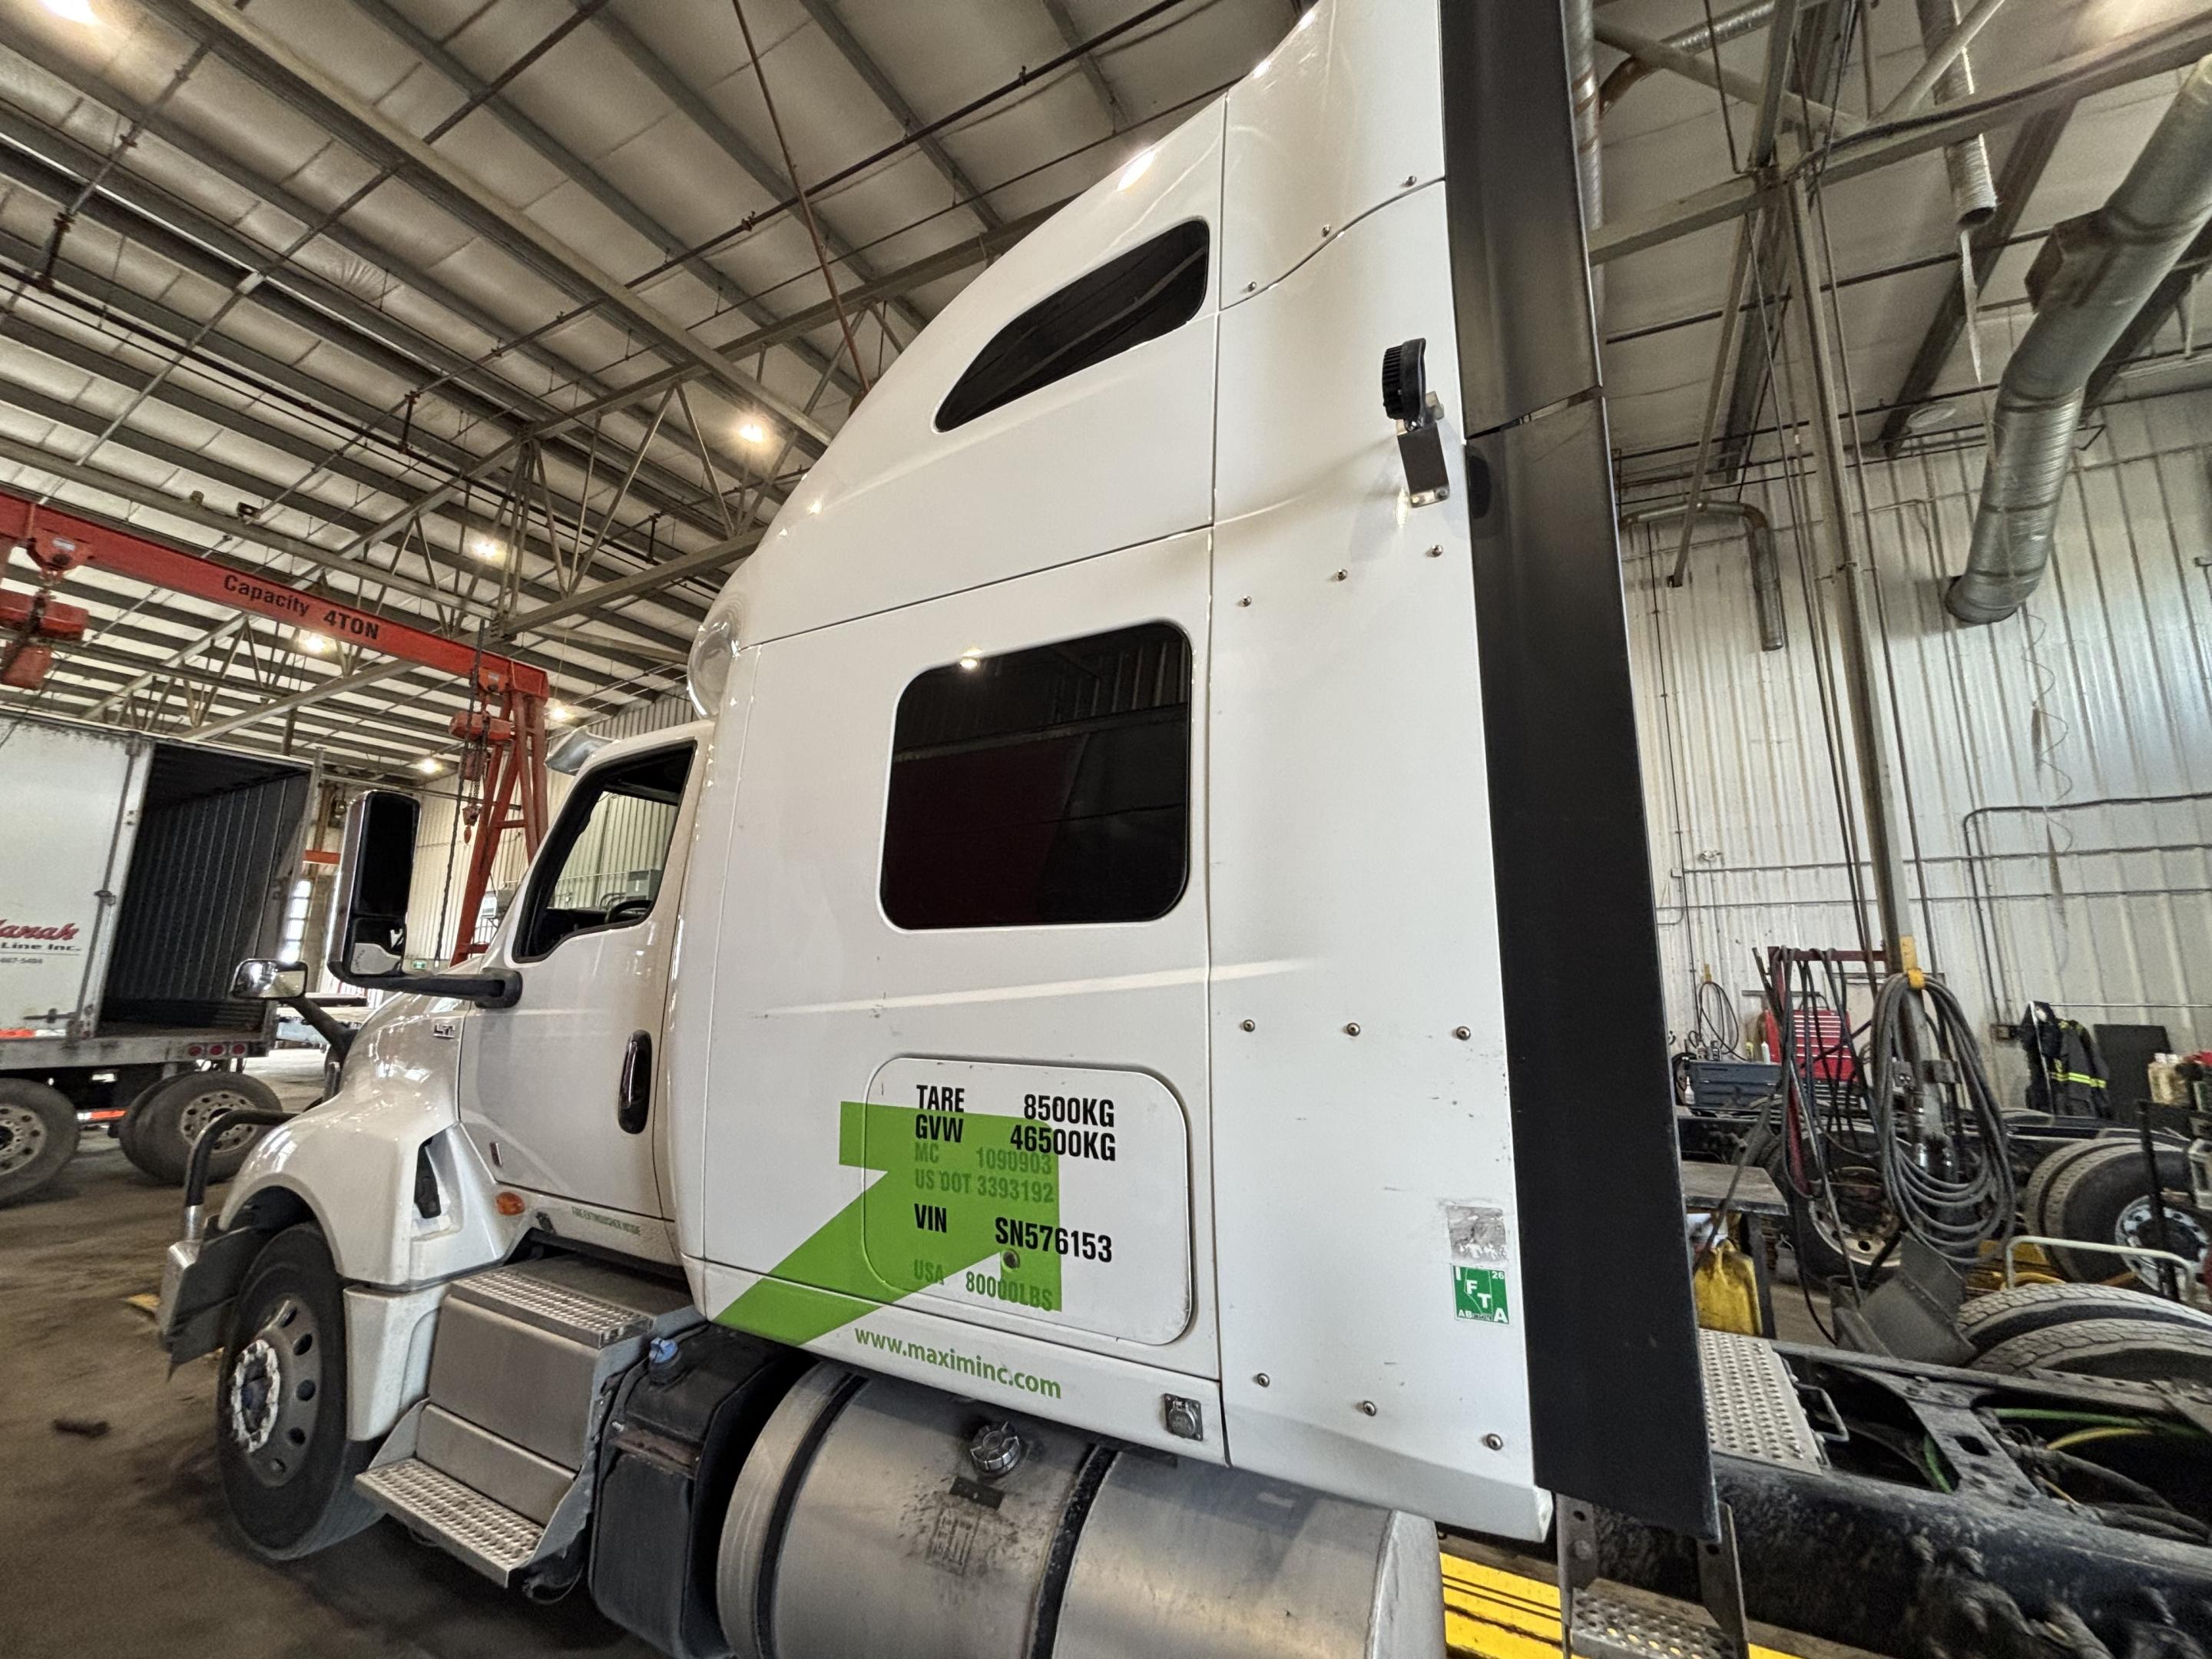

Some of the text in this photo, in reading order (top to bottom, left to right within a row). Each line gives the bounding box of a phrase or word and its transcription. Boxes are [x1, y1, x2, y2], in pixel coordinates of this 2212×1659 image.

[224, 575, 379, 640] Capacity 4TON
[1, 942, 42, 950] Line
[916, 1084, 1114, 1128] TARE 8500KG
[915, 1142, 1051, 1175] MC 1090903
[916, 1114, 1116, 1161] GVW 46500KG
[915, 1168, 1054, 1204] US DOT 3393192
[914, 1203, 1112, 1263] VIN SN576153
[914, 1259, 1052, 1311] USA 80000LBS
[1492, 1270, 1505, 1280] 26
[1459, 1309, 1472, 1318] AB
[855, 1327, 1061, 1399] www.maximinc.com
